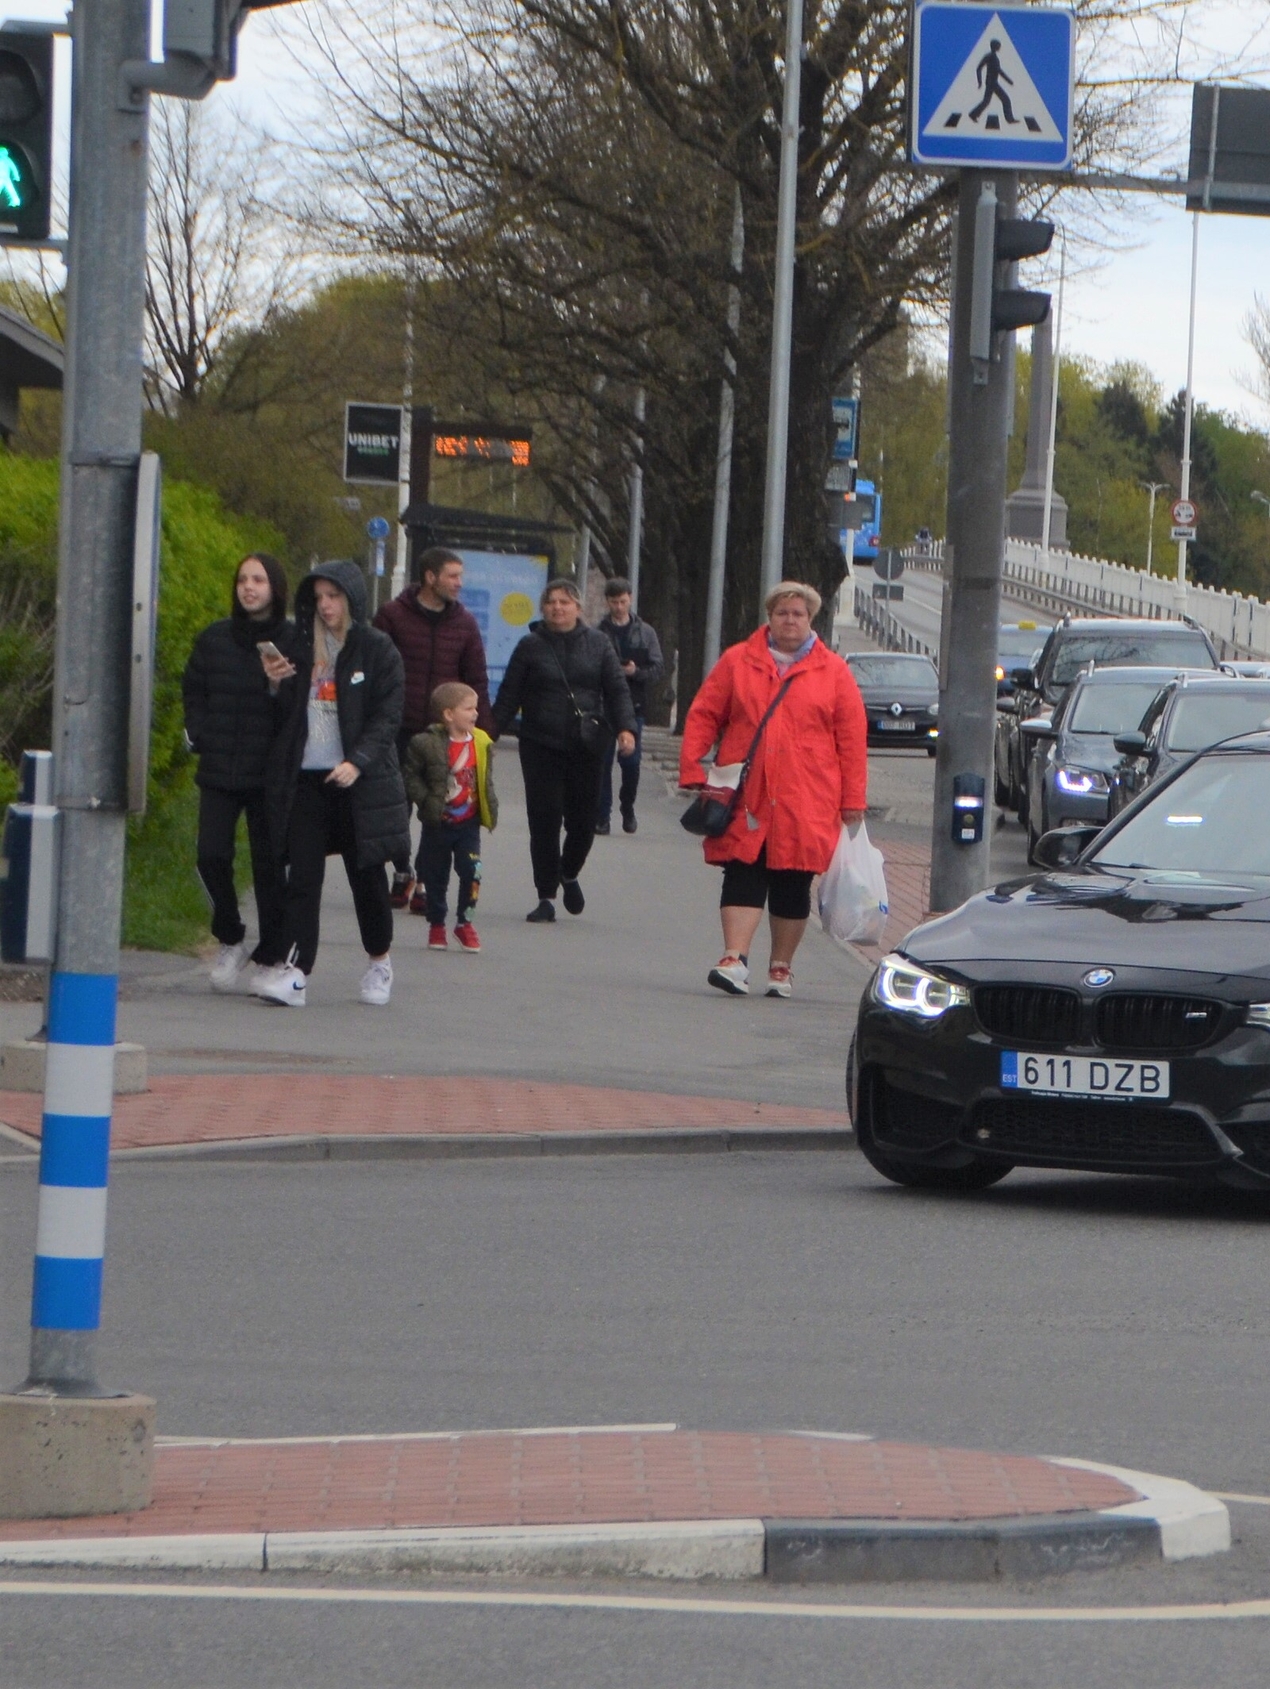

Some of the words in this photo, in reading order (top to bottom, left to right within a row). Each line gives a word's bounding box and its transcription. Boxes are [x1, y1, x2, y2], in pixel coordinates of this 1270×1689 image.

[348, 432, 399, 449] UNIBET
[1002, 1073, 1017, 1083] EST
[1024, 1056, 1072, 1088] 611
[1089, 1061, 1161, 1093] DZB
